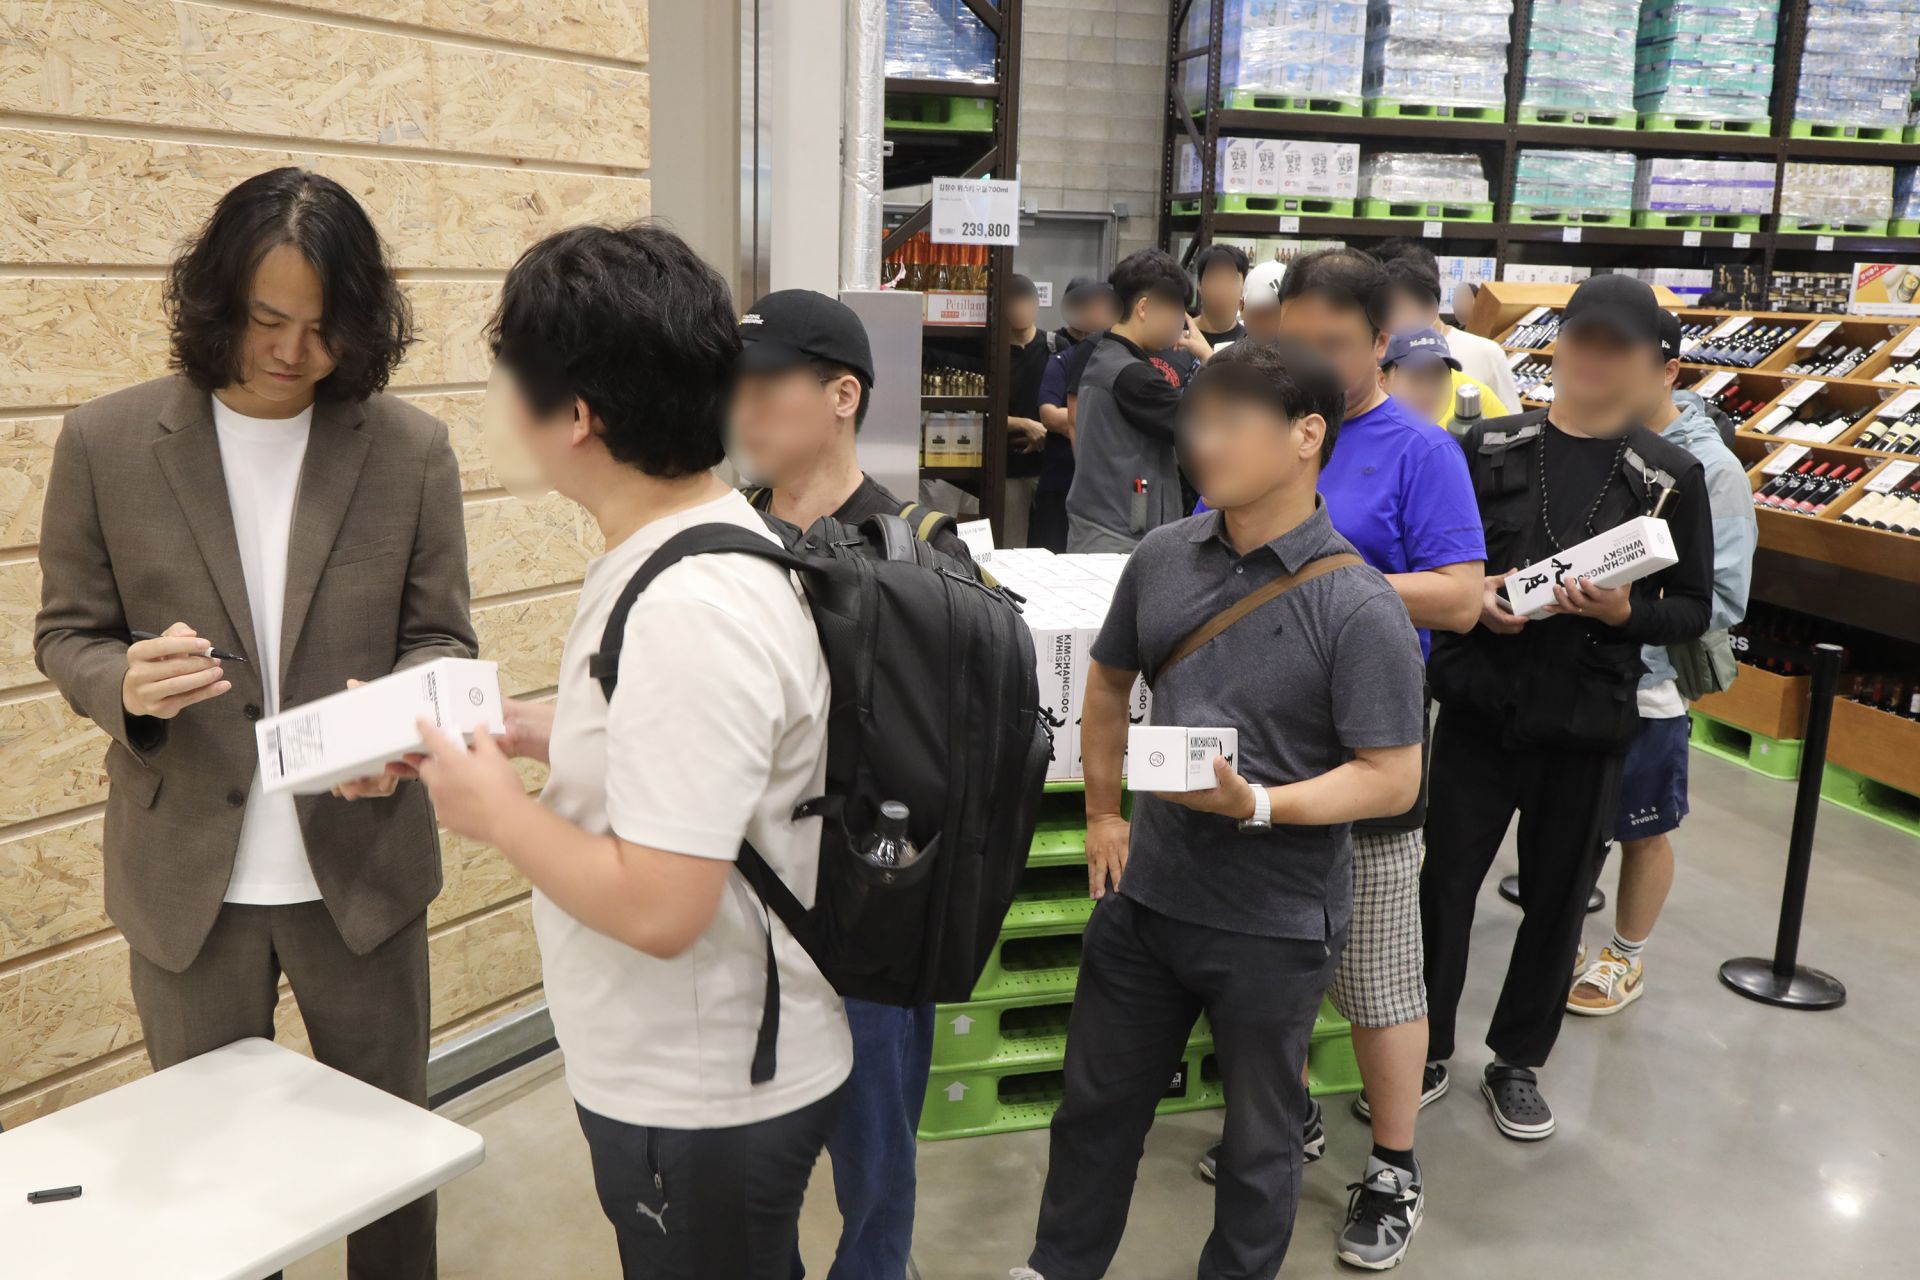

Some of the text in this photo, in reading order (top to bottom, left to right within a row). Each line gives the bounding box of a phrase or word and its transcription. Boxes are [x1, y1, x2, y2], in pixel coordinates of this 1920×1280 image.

[962, 222, 1010, 238] 239,800
[1603, 539, 1644, 563] WHISKY
[1055, 634, 1063, 677] WHISKY
[1061, 634, 1071, 713] KIMCHANGSOO
